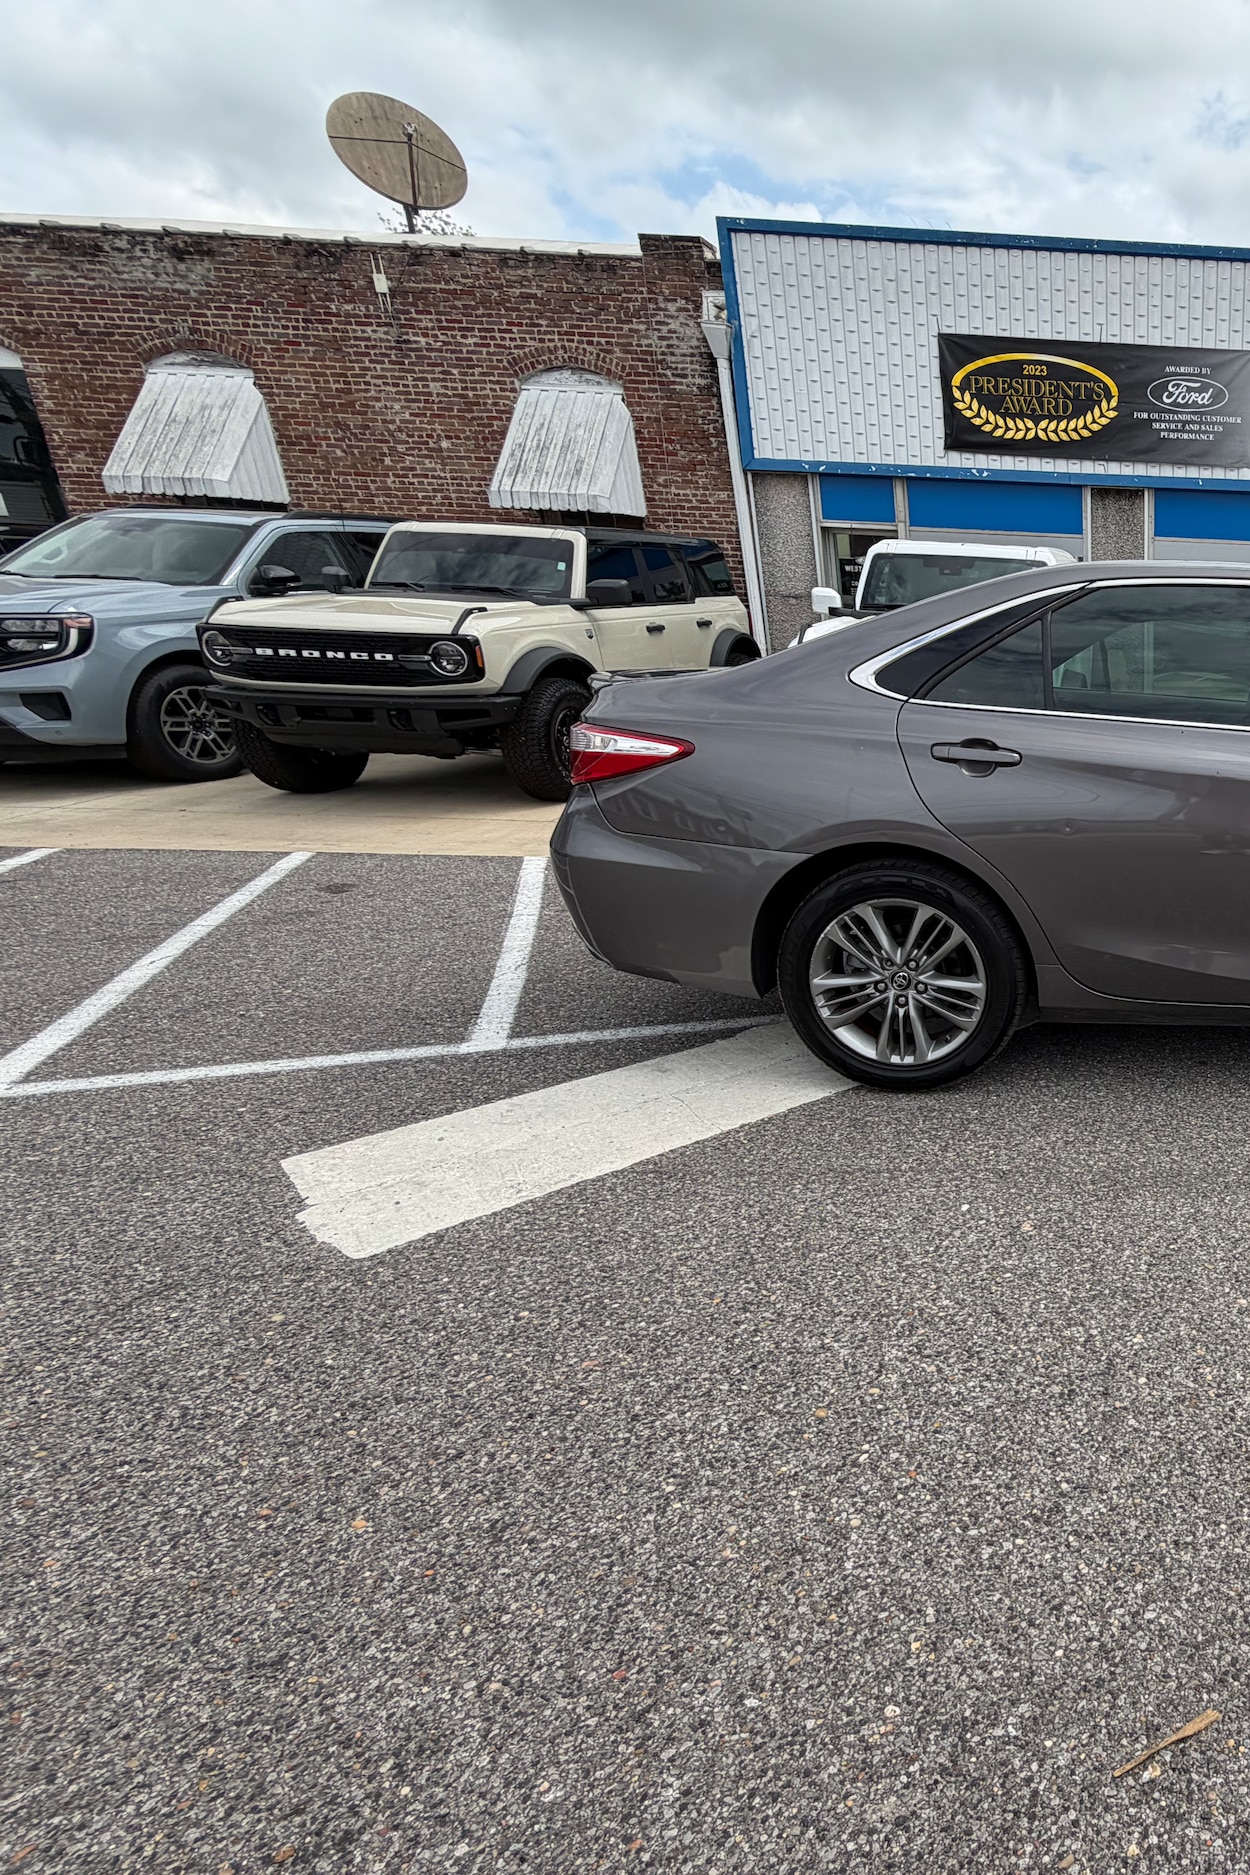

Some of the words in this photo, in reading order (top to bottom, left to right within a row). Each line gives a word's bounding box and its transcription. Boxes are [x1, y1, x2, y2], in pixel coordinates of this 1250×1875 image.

[1022, 364, 1048, 376] 2023
[1164, 365, 1200, 374] AWARDED
[1201, 367, 1212, 375] BY
[969, 375, 1105, 400] PRESIDENT'S
[1162, 380, 1214, 405] Ford
[999, 396, 1073, 417] AWARD
[1133, 411, 1149, 420] FOR
[1150, 413, 1201, 422] OUTSTANDING
[1202, 415, 1242, 424] CUSTOMER
[1151, 422, 1183, 430] SERVICE
[1184, 423, 1200, 431] AND
[1200, 424, 1224, 432] SALES
[1160, 431, 1215, 441] PERFORMANCE
[844, 564, 862, 573] WEST
[254, 647, 394, 661] BRONCO
